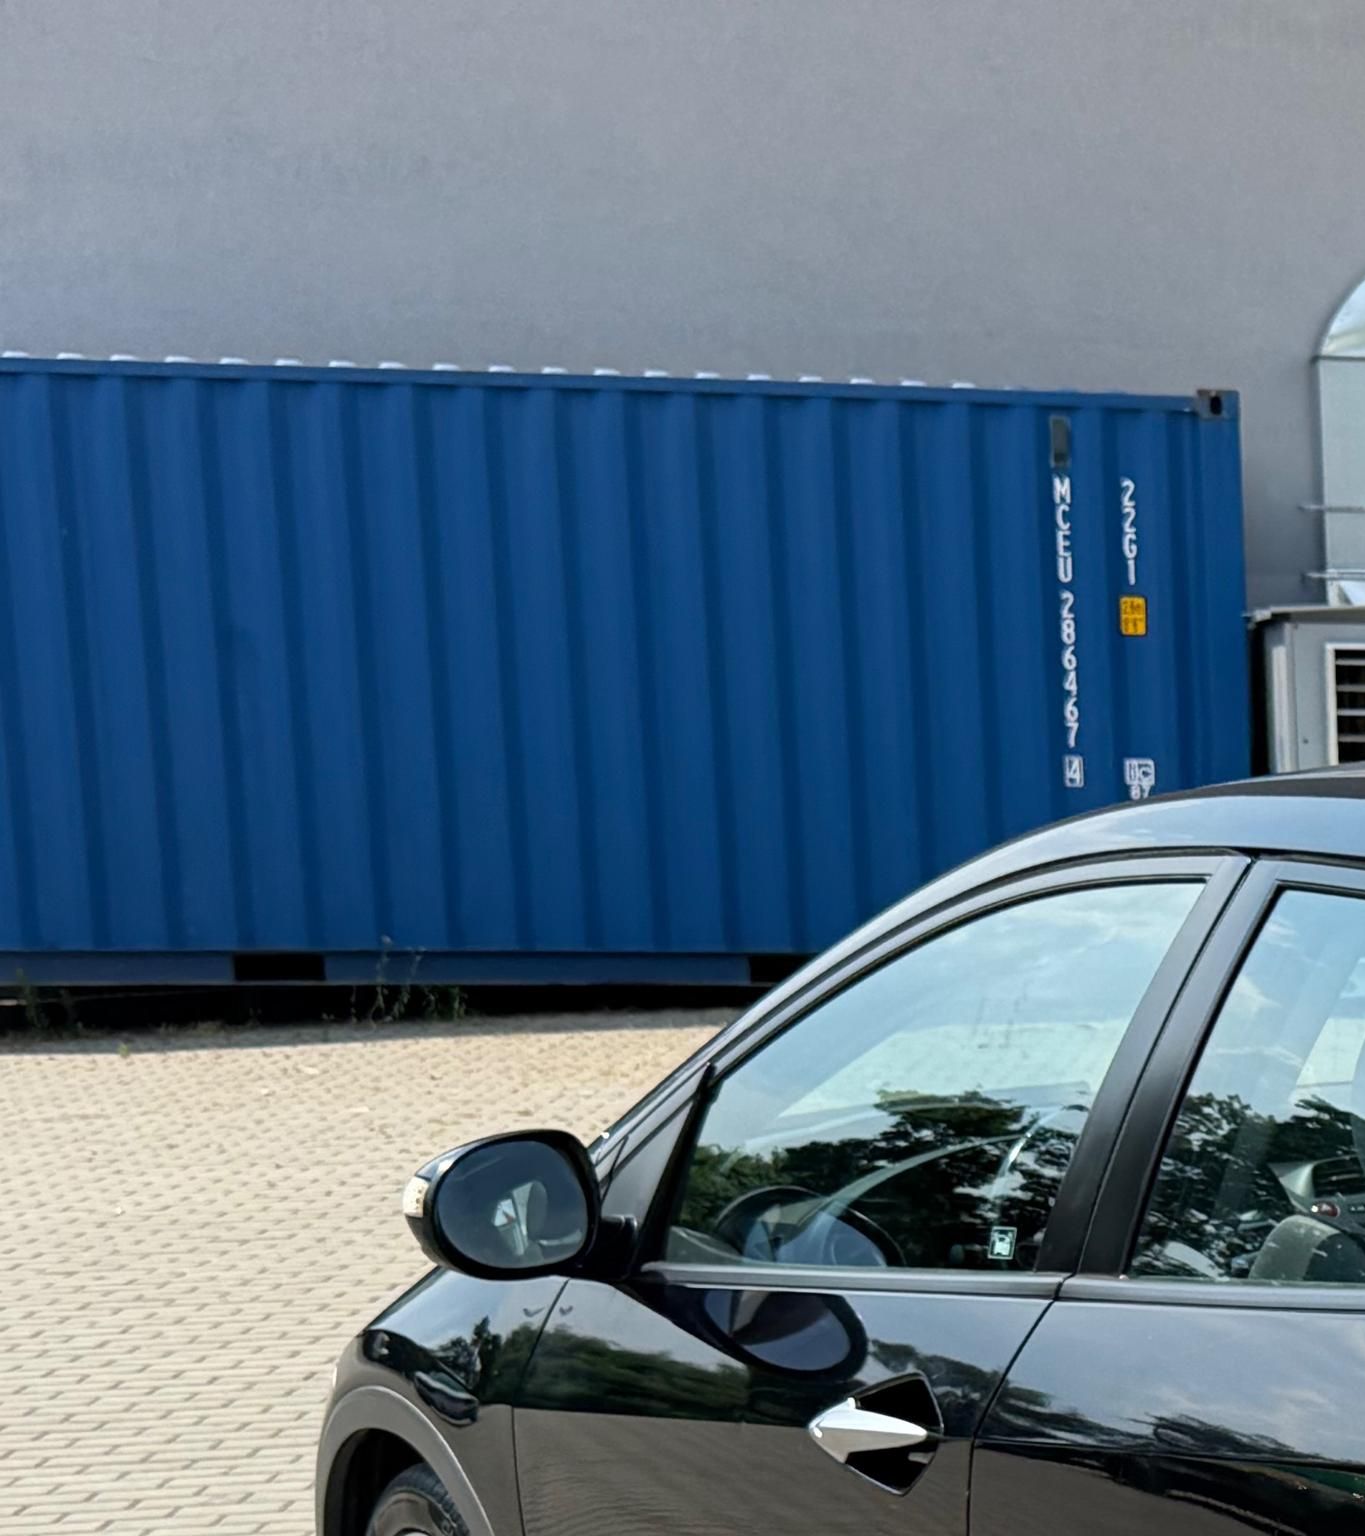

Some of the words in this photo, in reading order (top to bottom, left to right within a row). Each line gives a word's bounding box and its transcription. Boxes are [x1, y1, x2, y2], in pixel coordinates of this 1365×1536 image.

[1053, 476, 1072, 583] MCEU
[1120, 478, 1138, 585] 22G1
[1060, 591, 1080, 748] 286467
